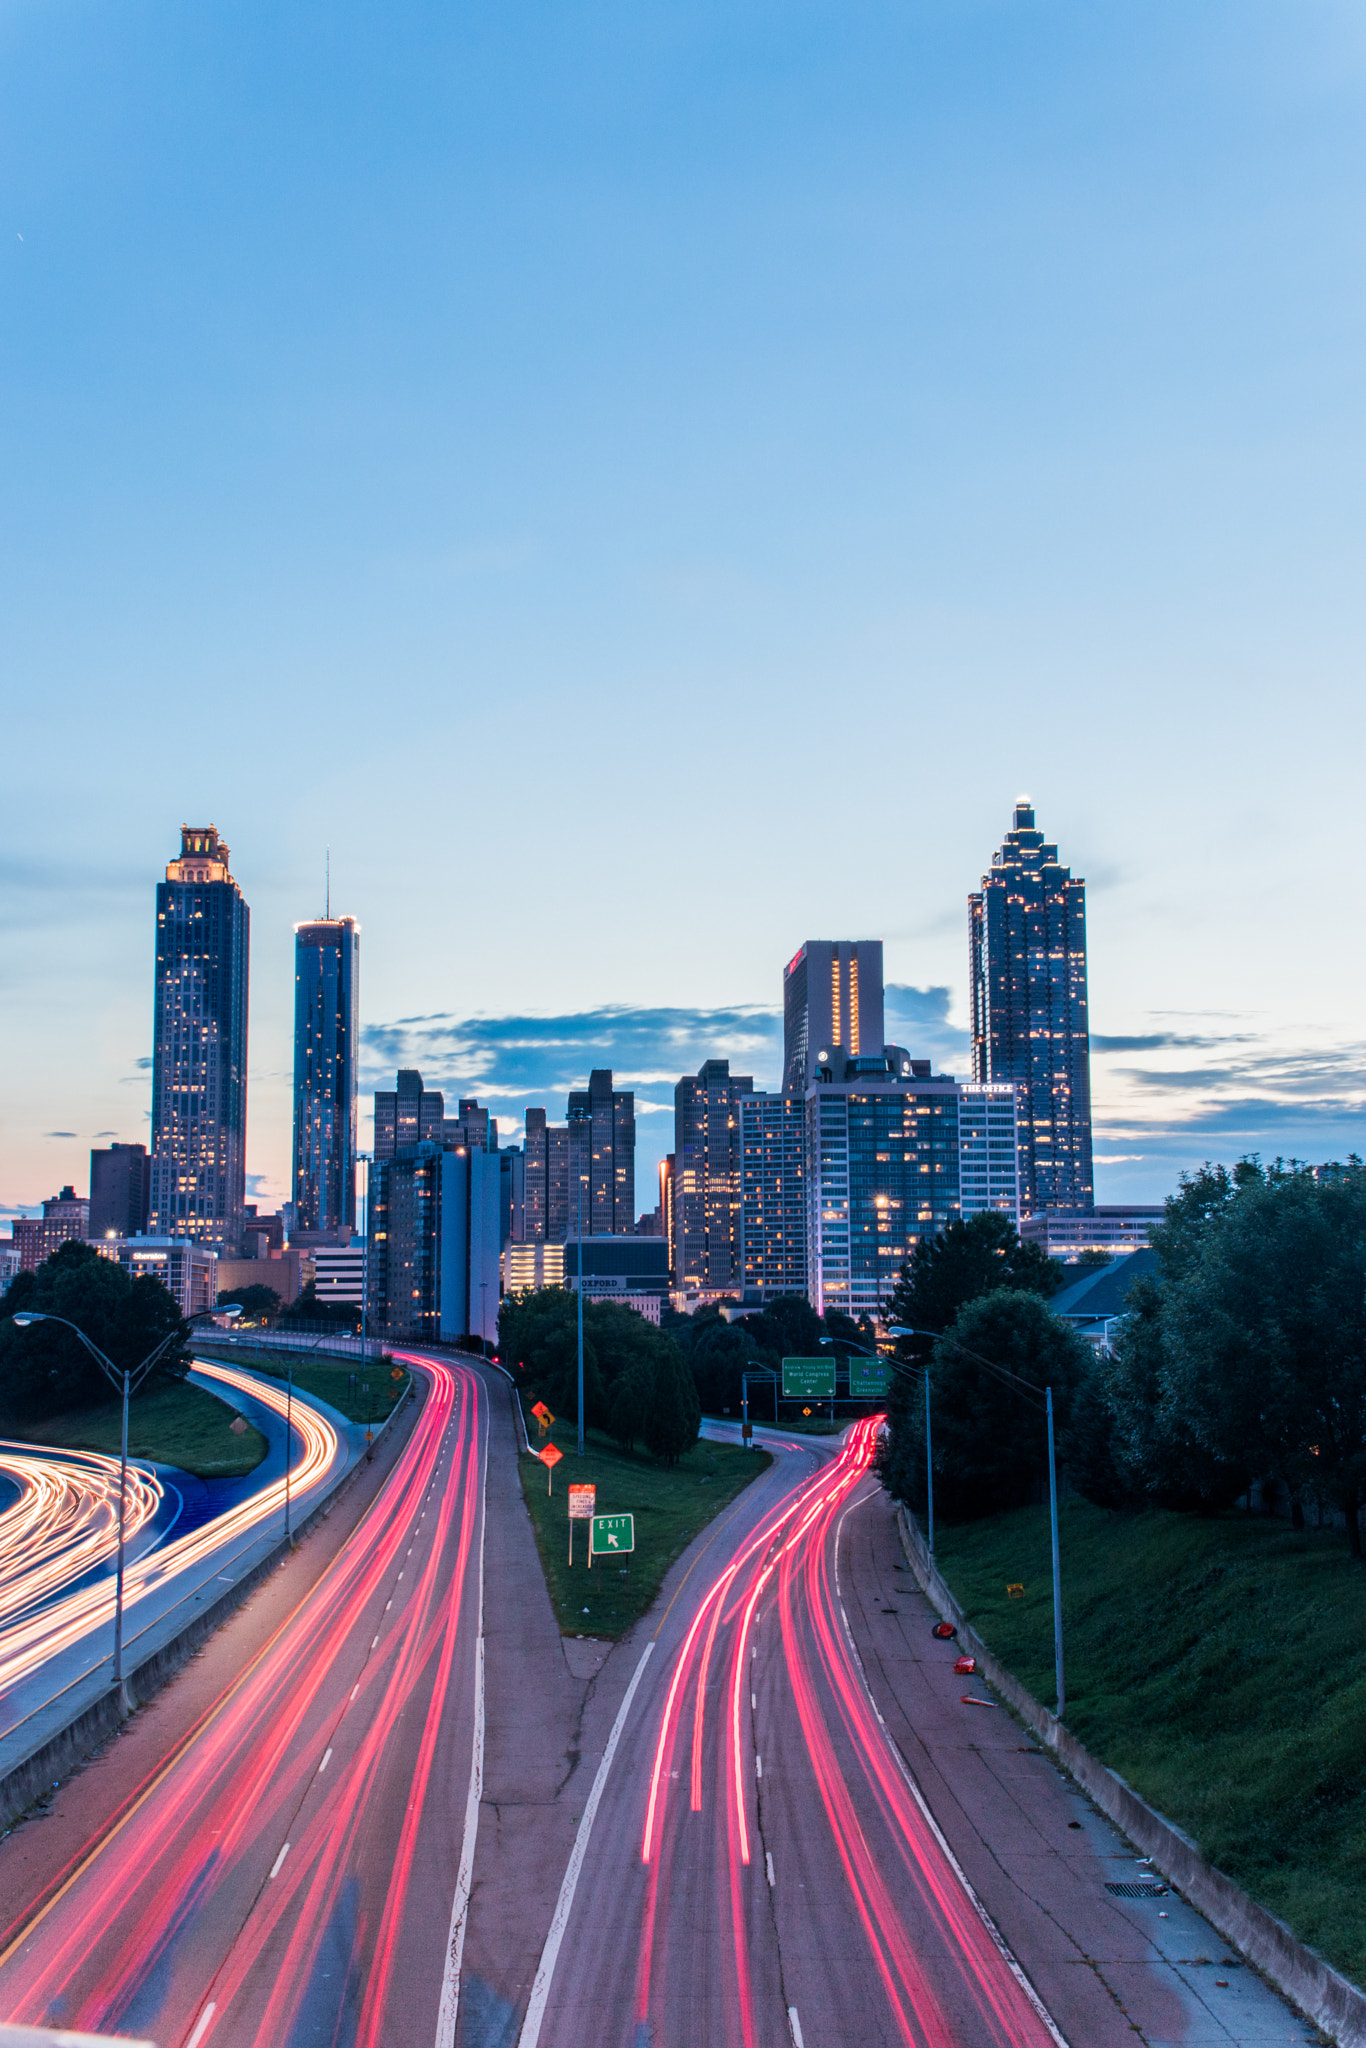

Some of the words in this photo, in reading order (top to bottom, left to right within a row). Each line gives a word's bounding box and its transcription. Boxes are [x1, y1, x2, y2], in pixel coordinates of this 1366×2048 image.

[961, 1084, 981, 1093] THE
[982, 1084, 1013, 1093] OFFICE
[133, 1252, 167, 1261] Sheraton
[599, 1518, 626, 1530] EXIT
